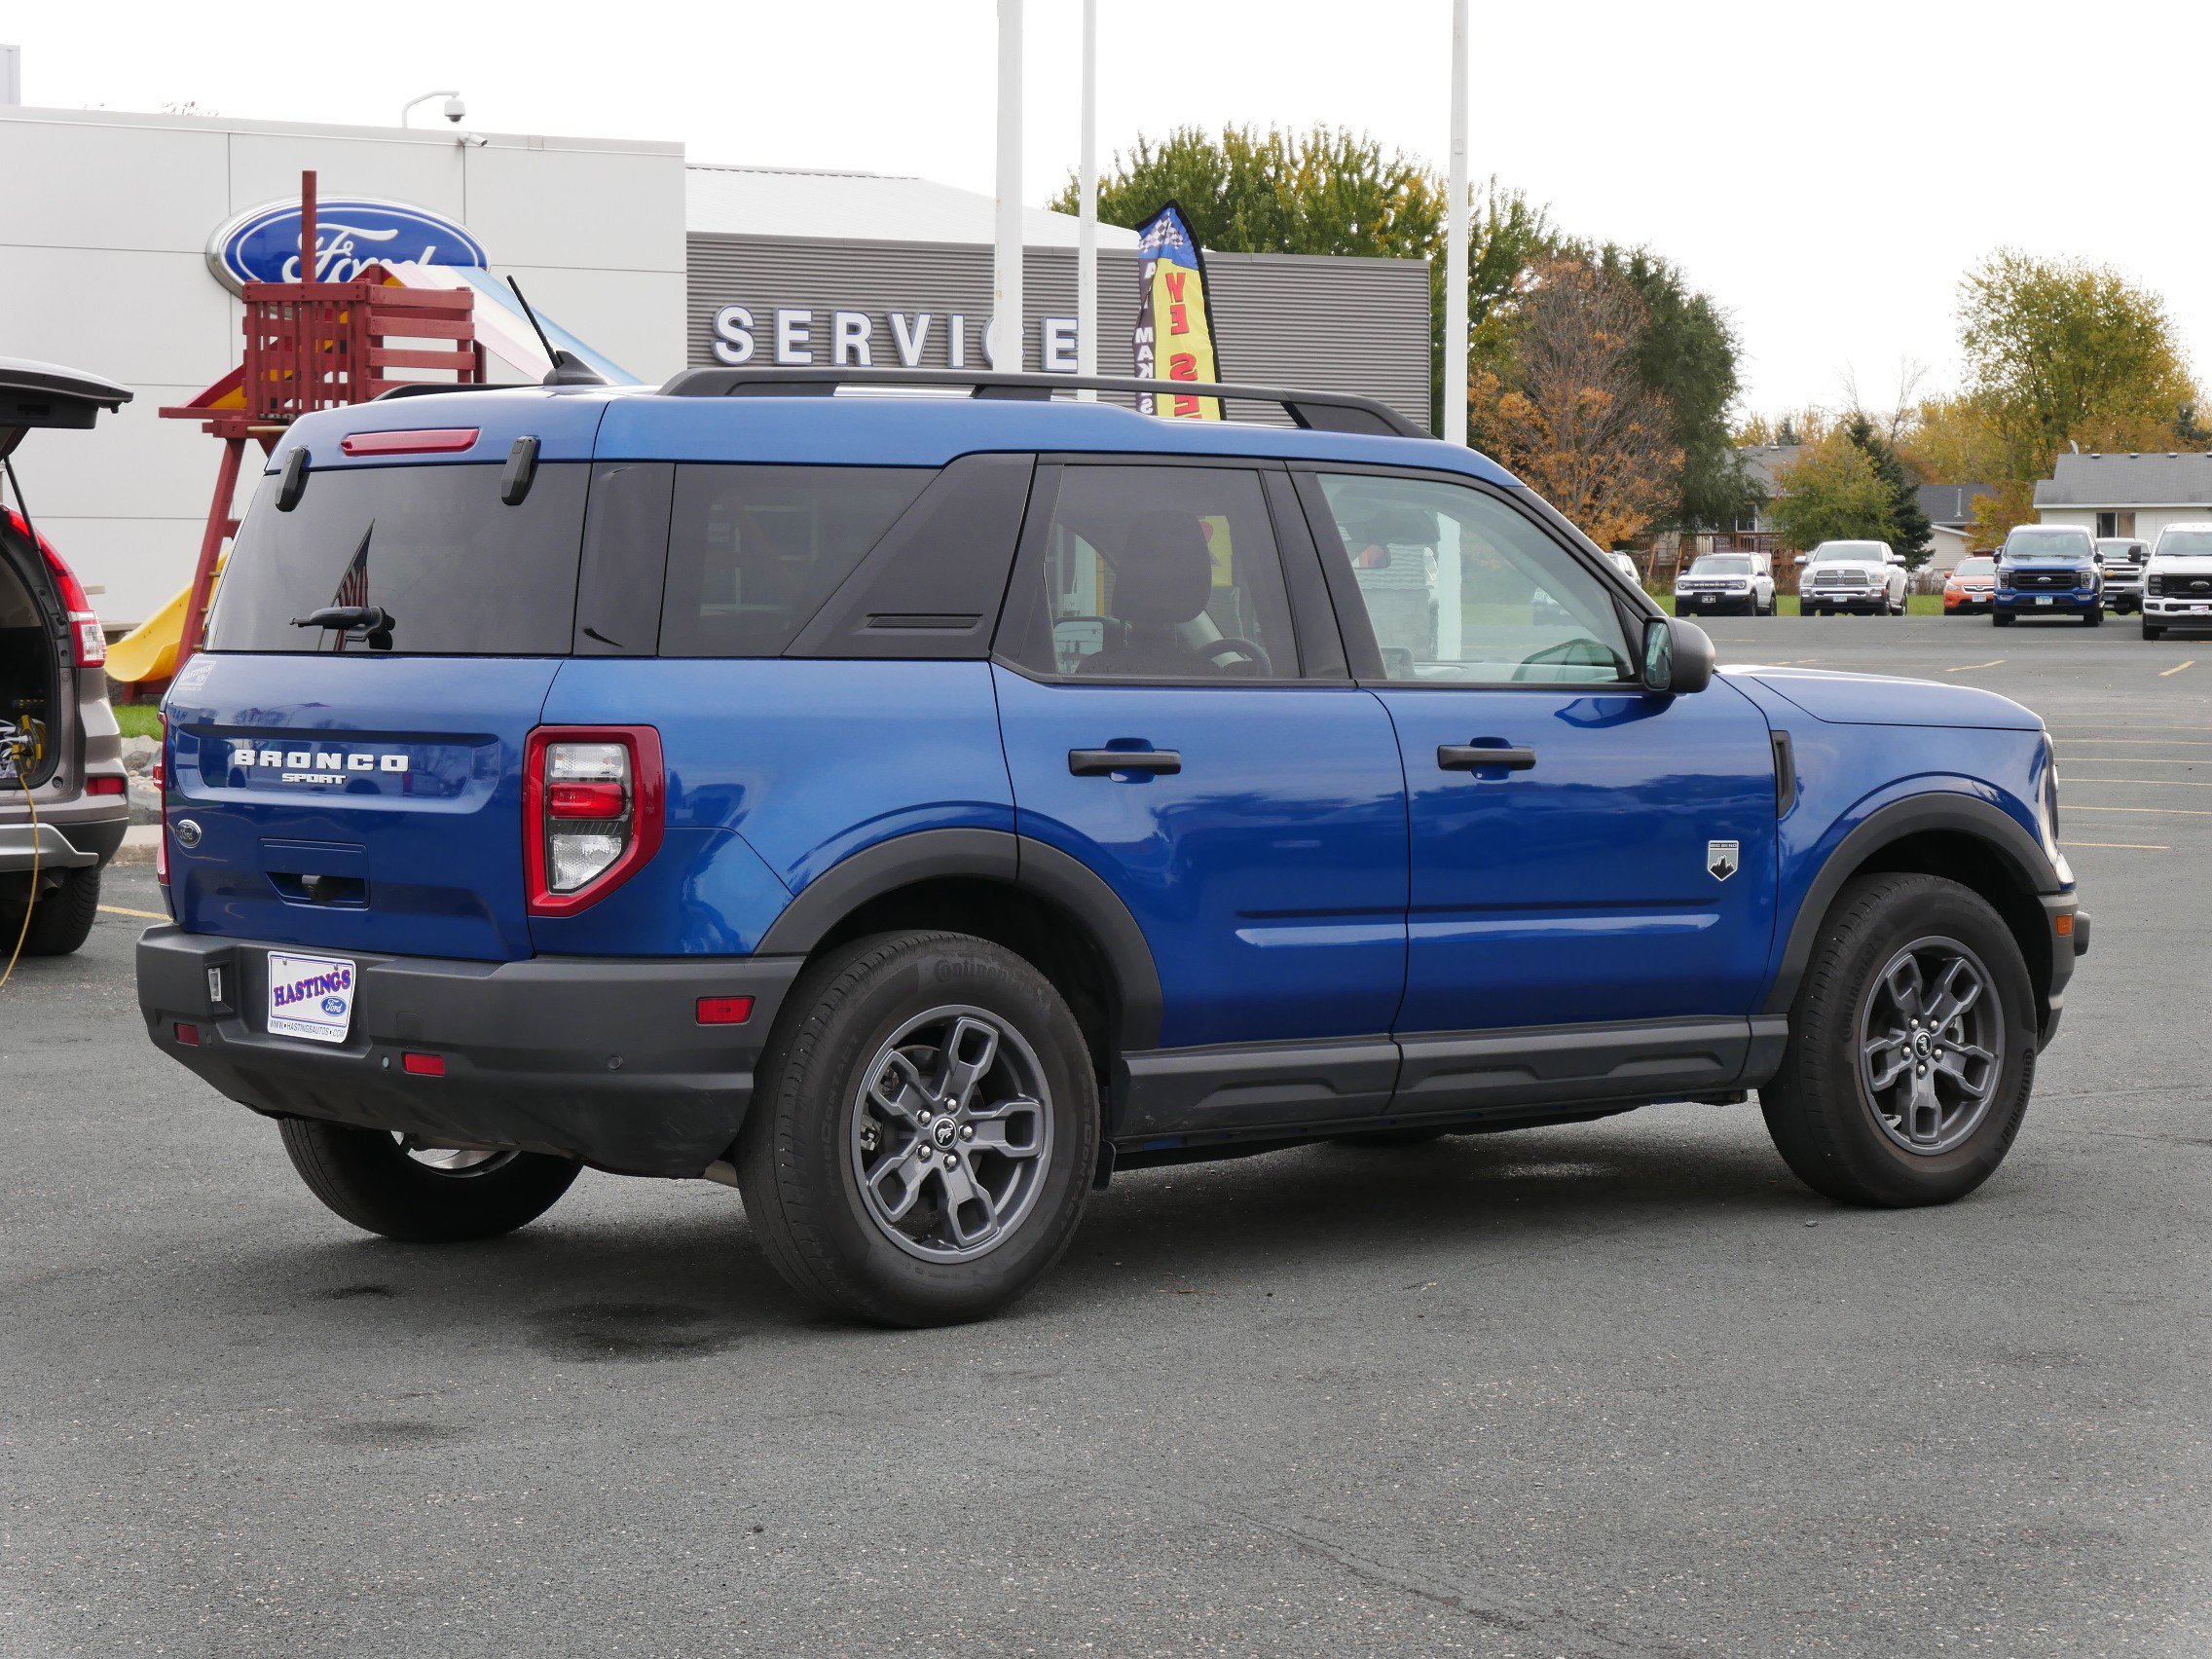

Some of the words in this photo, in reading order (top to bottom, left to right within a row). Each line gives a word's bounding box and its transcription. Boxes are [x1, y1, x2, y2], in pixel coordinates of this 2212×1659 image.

[234, 749, 409, 772] BRONCO
[281, 773, 347, 785] SPORT
[274, 969, 351, 1008] HASTINGS
[325, 998, 343, 1014] Ford
